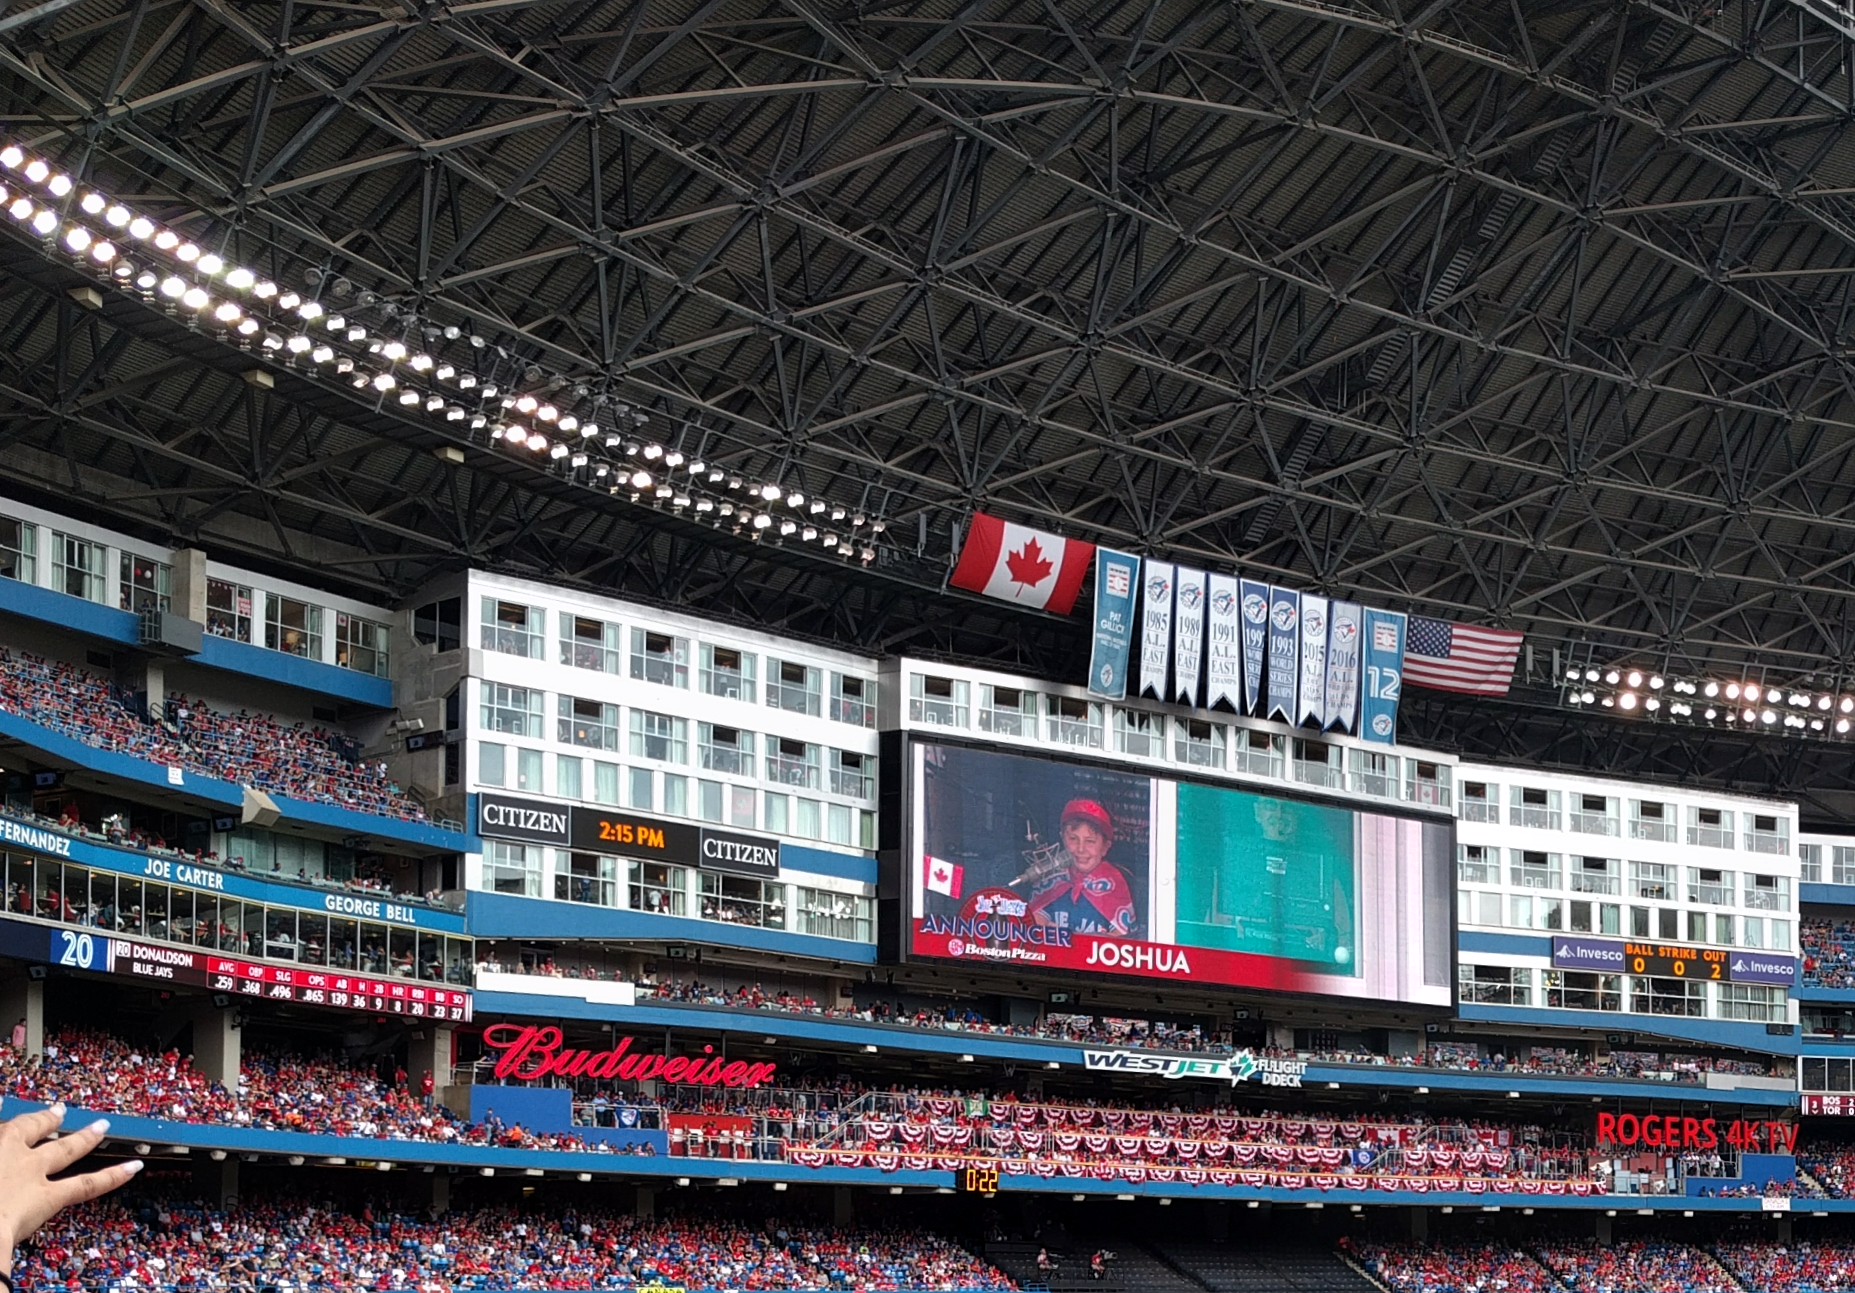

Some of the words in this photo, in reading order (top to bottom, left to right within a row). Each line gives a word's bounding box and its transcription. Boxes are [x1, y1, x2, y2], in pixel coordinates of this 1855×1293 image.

[1146, 610, 1167, 631] 1985
[1179, 616, 1200, 637] 1989
[1213, 623, 1235, 642] 1991
[1143, 648, 1164, 665] EAST
[1212, 645, 1236, 658] A.L.
[1271, 636, 1293, 656] 1993
[1178, 654, 1197, 671] EAST
[1211, 660, 1235, 675] EAST
[1271, 659, 1293, 669] WORLD
[1331, 649, 1356, 668] 2016
[1270, 672, 1292, 683] SERIES
[1368, 666, 1399, 701] 12
[482, 804, 567, 835] CITIZEN
[600, 821, 633, 843] 2:15
[638, 827, 665, 848] PM
[703, 838, 777, 867] CITIZEN
[145, 858, 170, 878] JOE
[176, 865, 223, 890] CARTER
[325, 894, 380, 917] GEORGE
[386, 905, 415, 923] BELL
[920, 913, 1072, 948] ANNOUNCER
[61, 931, 93, 968] 20
[133, 945, 192, 967] DONALDSON
[1086, 941, 1191, 974] JOSHUA
[1577, 947, 1623, 962] Invesco
[1626, 944, 1653, 955] BALL
[1659, 947, 1697, 959] STRIKE
[1704, 951, 1726, 962] OUT
[133, 962, 153, 975] BLUE
[155, 965, 173, 979] JAYS
[219, 962, 234, 973] AVG
[276, 971, 291, 982] SLG
[309, 975, 325, 986] OPS
[1634, 958, 1645, 973] 0
[1711, 965, 1721, 978] 2
[1751, 961, 1794, 975] Invesco
[270, 985, 291, 999] .496
[303, 989, 324, 1002] .865
[331, 992, 347, 1006] 139
[352, 995, 365, 1008] 36
[484, 1024, 776, 1088] Budweiser
[1087, 1053, 1226, 1075] WESTJET
[1822, 1106, 1841, 1115] TOR
[1598, 1112, 1717, 1149] ROGERS
[1727, 1120, 1760, 1150] 4K
[1768, 1122, 1800, 1152] TV
[966, 1168, 998, 1193] 0:22
